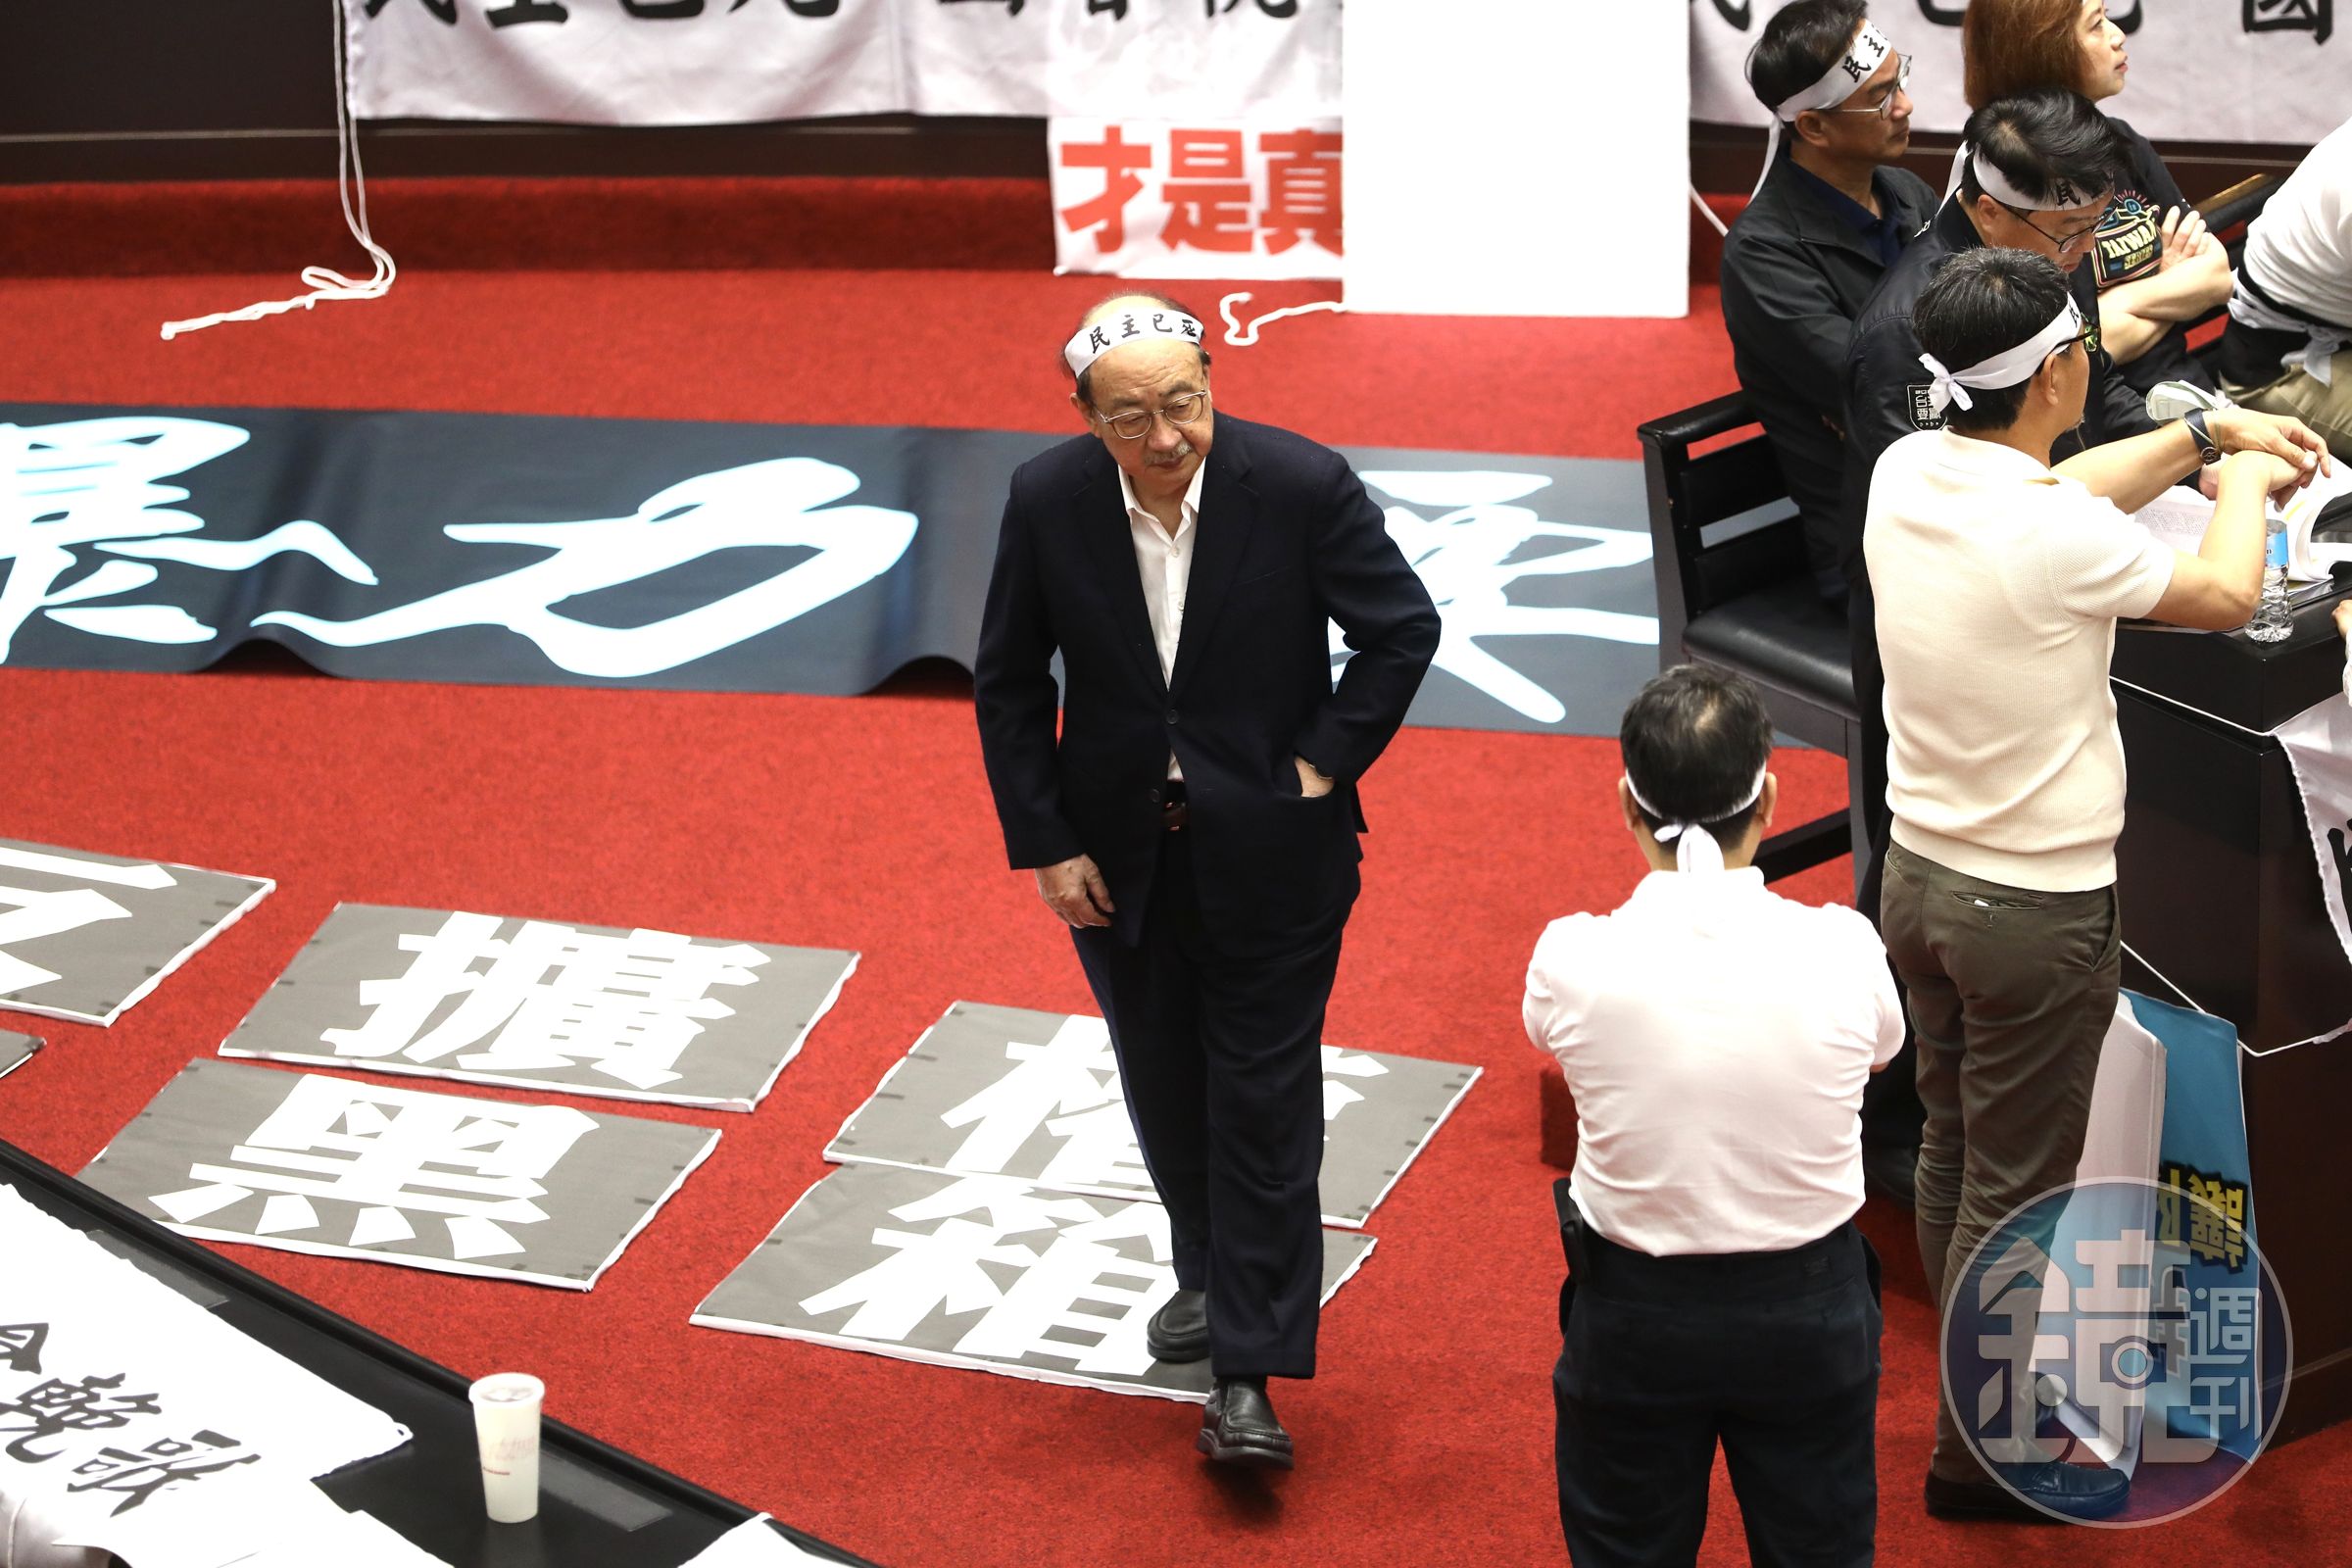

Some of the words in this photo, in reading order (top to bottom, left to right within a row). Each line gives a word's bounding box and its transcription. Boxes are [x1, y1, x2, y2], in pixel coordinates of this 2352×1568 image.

[1842, 24, 1887, 82] 民主
[1060, 125, 1344, 257] 才是真
[1090, 314, 1197, 354] 民主已死
[148, 1074, 600, 1259] 黑
